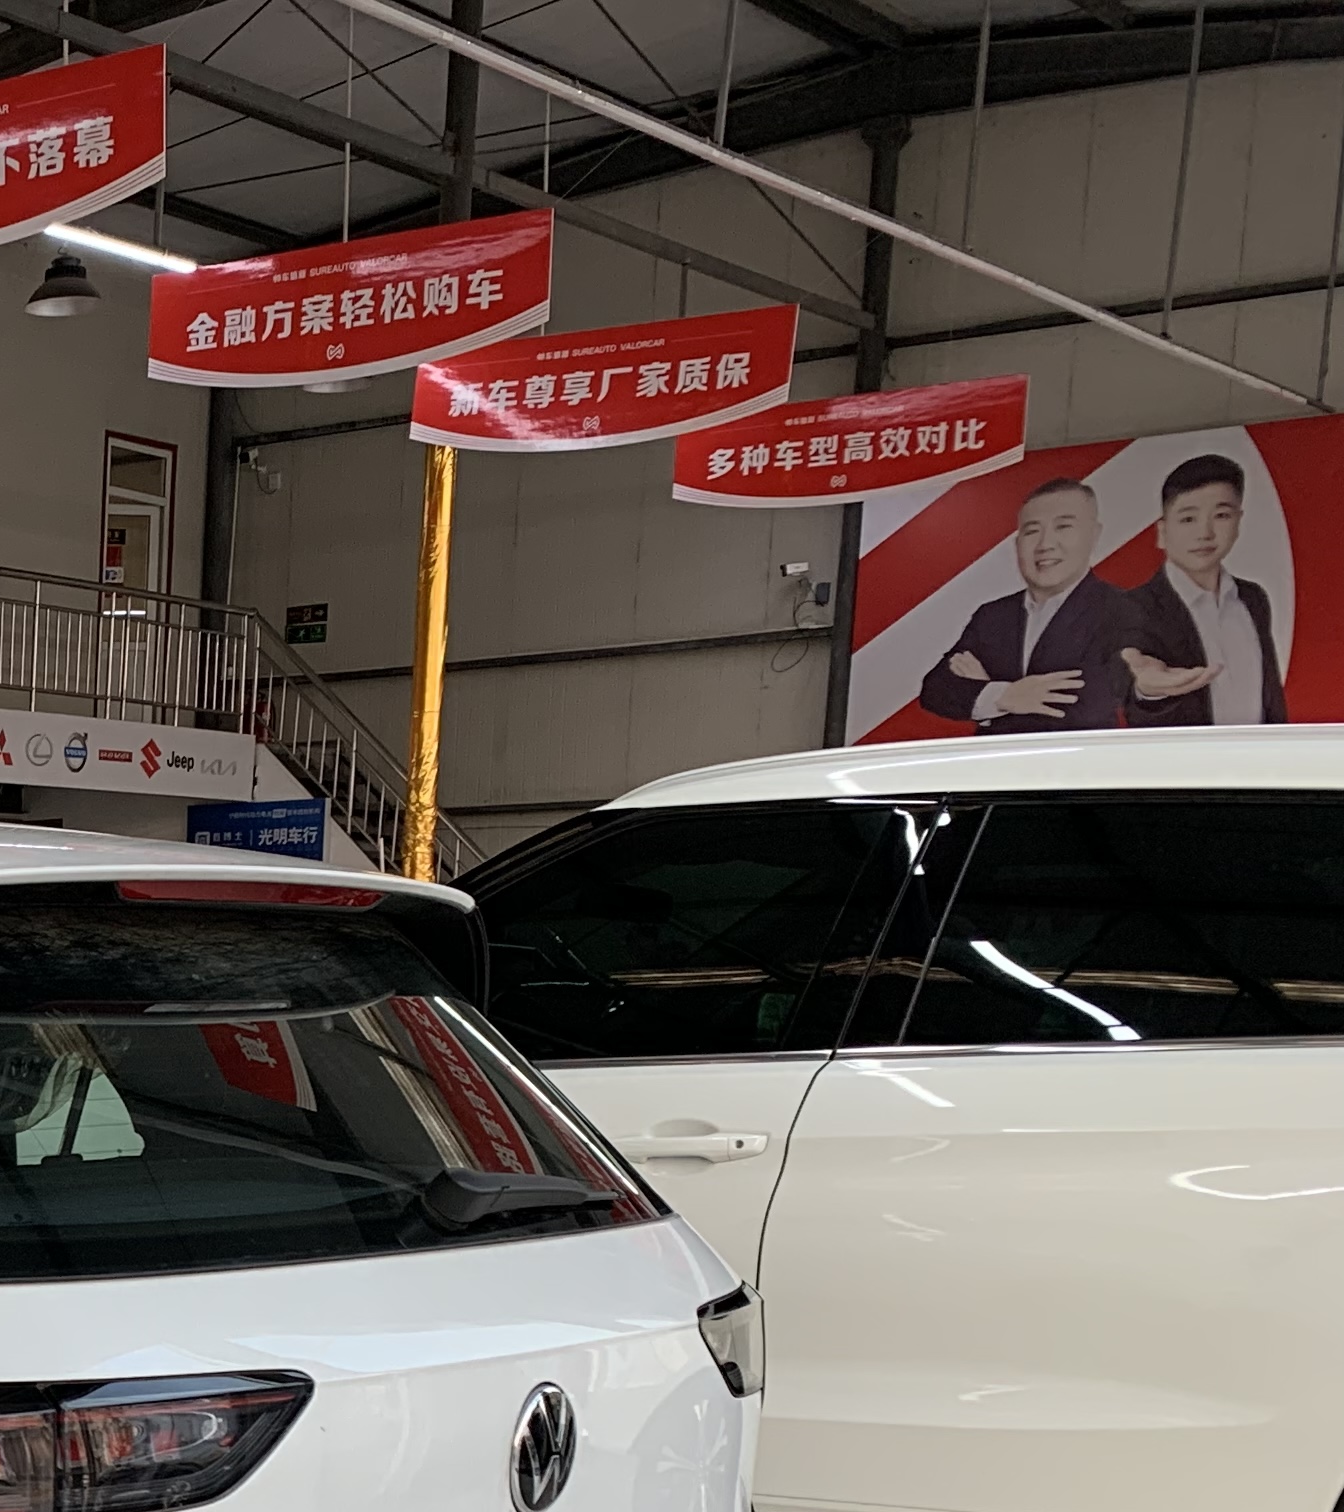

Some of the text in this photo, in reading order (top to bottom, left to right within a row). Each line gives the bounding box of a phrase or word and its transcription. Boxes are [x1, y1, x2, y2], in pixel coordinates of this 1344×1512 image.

[310, 262, 356, 277] SUREAUTO
[186, 269, 504, 352] 金融方案轻松购车
[572, 344, 616, 357] SUREAUTO
[620, 338, 665, 350] VALORCAR
[449, 351, 751, 417] 新车尊享厂家质保
[706, 418, 986, 480] 多种车型高效对比
[167, 751, 194, 772] Jeep
[258, 826, 318, 846] 光明车行
